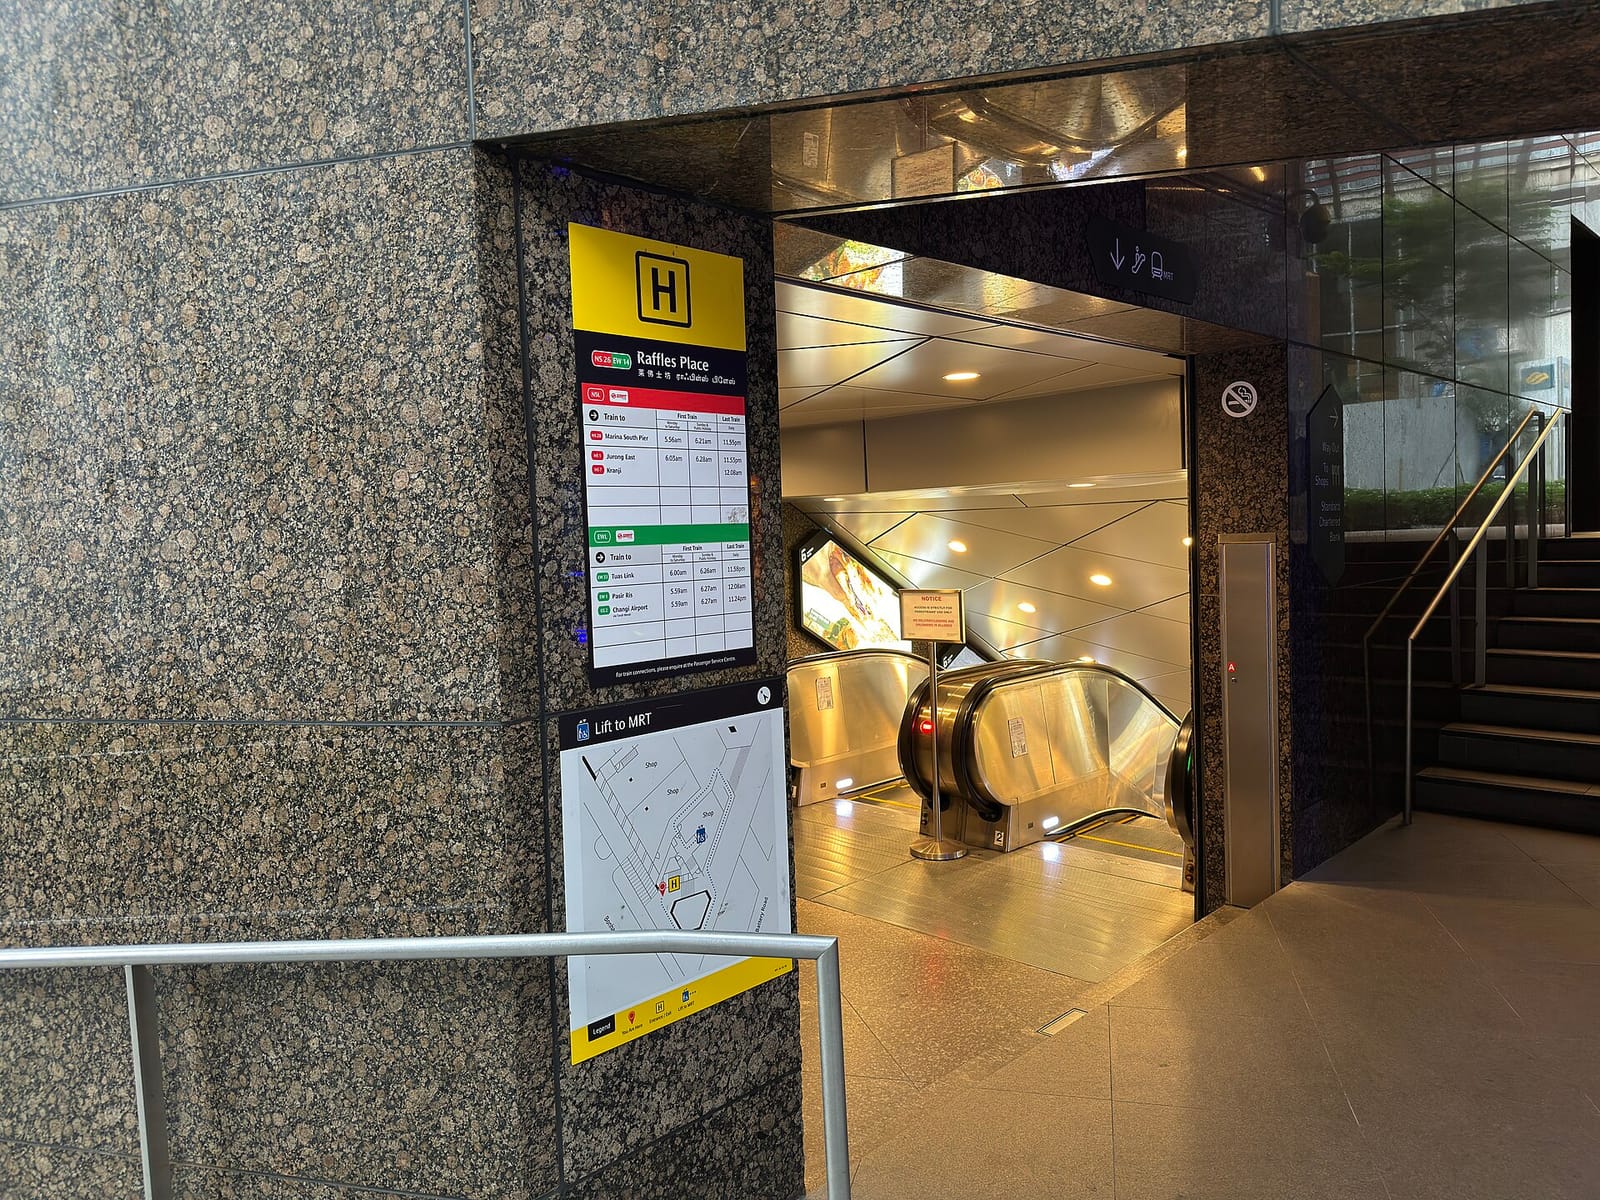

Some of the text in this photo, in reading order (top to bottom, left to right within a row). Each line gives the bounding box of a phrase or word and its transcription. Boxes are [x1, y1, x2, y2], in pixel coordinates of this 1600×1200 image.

[1163, 271, 1174, 281] MRT
[651, 267, 677, 313] H
[594, 355, 612, 364] NS 26
[612, 357, 622, 365] EW
[637, 350, 709, 371] Raffles Place
[604, 412, 626, 422] Train to
[677, 412, 687, 420] First
[604, 432, 623, 440] Marina
[623, 433, 638, 441] South
[606, 453, 625, 461] Jurong
[606, 467, 622, 475] Kranji
[610, 553, 625, 561] Train
[612, 604, 648, 613] Changi Airport
[656, 665, 669, 673] please
[669, 663, 683, 671] enquire
[693, 659, 711, 668] Passenger
[595, 712, 652, 735] Lift to MRT
[666, 788, 679, 796] Shop
[702, 810, 714, 818] Shop
[996, 832, 1002, 842] 2
[755, 896, 769, 933] Battery Road
[592, 1022, 611, 1036] Legend
